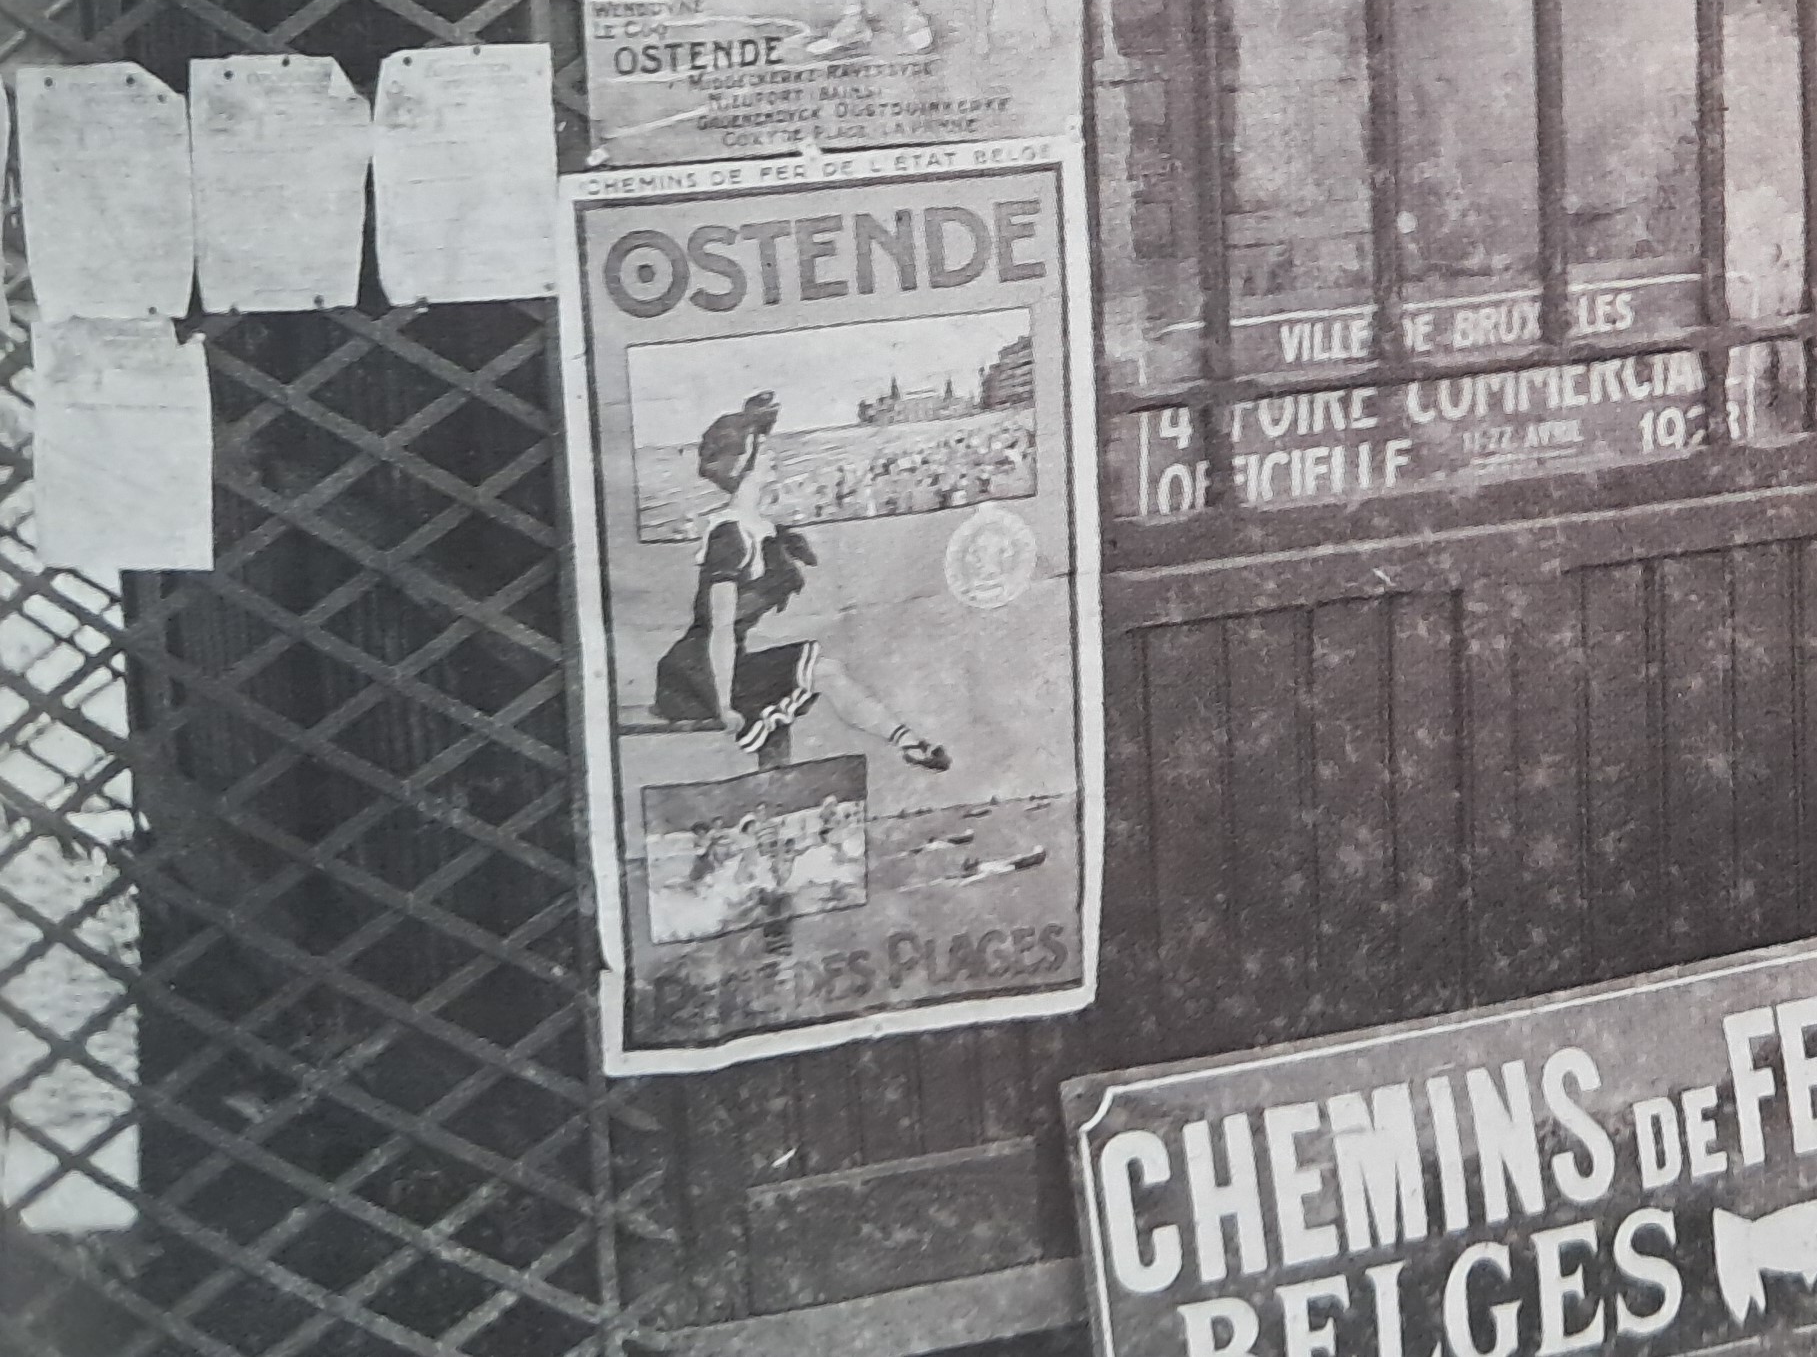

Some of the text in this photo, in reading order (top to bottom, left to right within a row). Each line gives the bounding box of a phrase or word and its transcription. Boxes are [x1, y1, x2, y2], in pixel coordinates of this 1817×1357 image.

[613, 35, 784, 76] OSTENDE
[710, 168, 742, 187] DE
[822, 159, 853, 177] DE
[603, 198, 1047, 320] OSTENDE
[1279, 319, 1371, 364] VILLE
[1452, 293, 1635, 350] BRUXLES
[1404, 346, 1741, 426] COMMERCIA
[886, 922, 1069, 991] PLAGES
[1099, 1046, 1618, 1298] CHEMINS
[1633, 1084, 1729, 1192] DE
